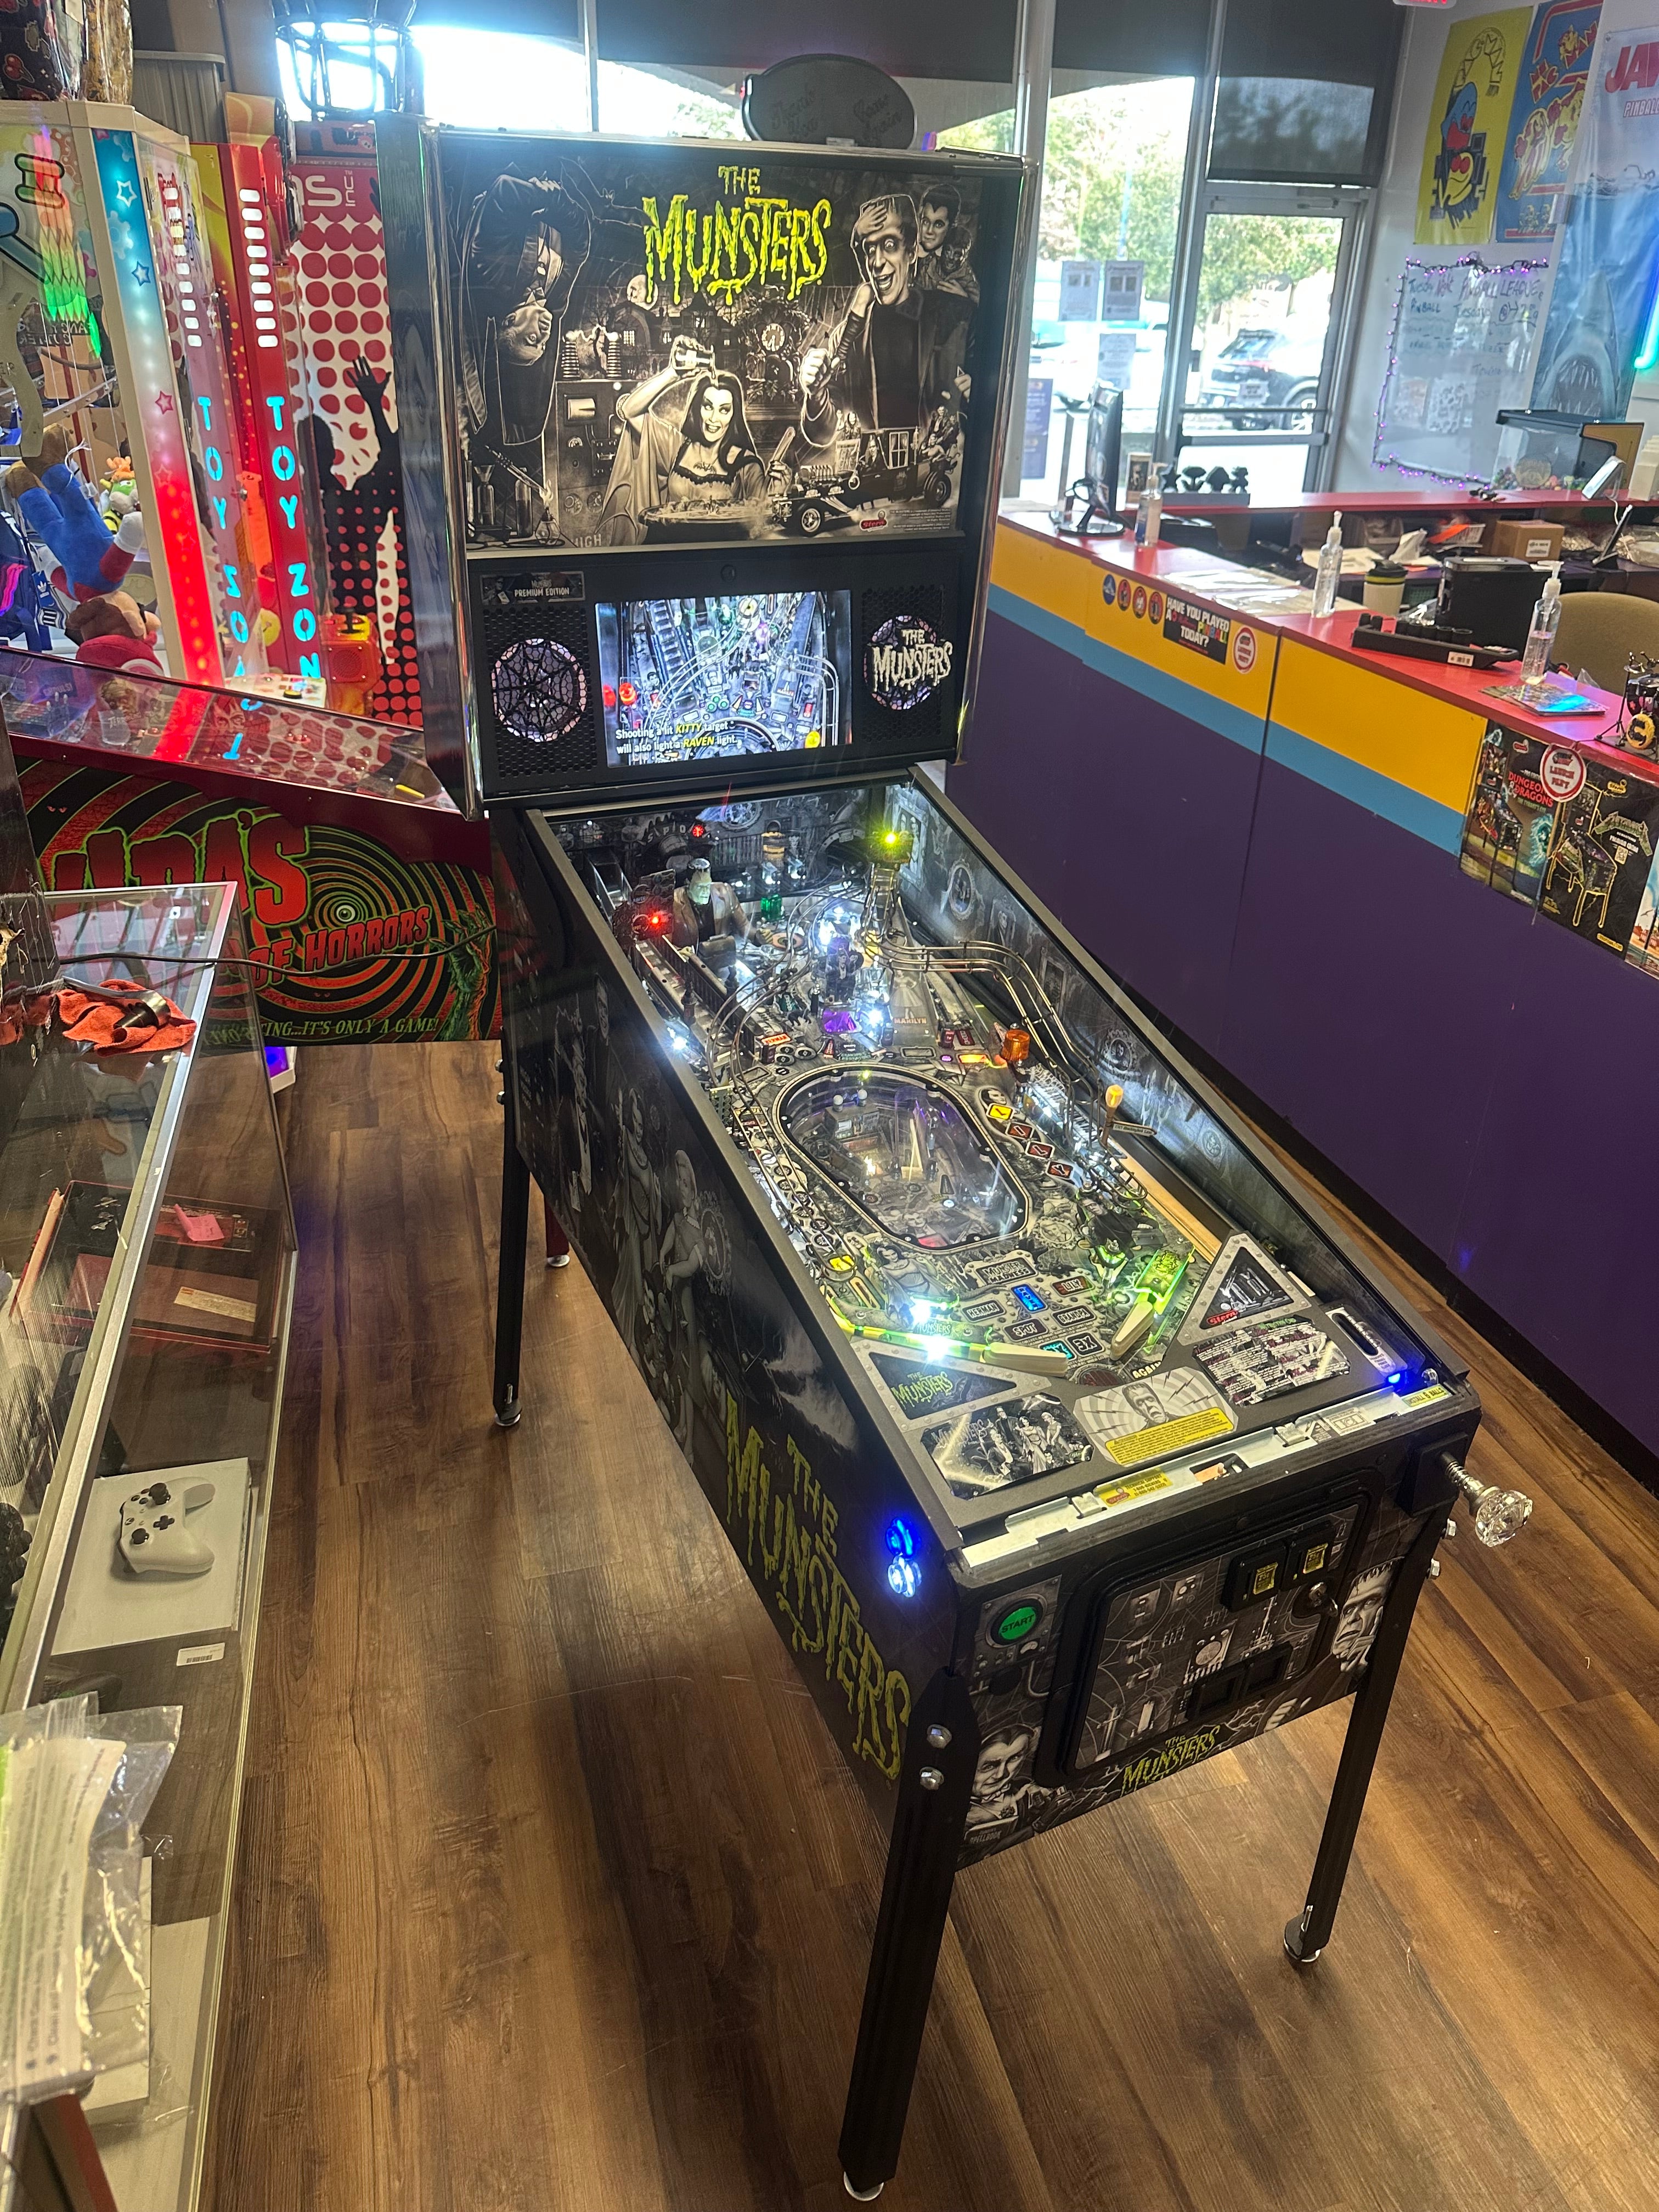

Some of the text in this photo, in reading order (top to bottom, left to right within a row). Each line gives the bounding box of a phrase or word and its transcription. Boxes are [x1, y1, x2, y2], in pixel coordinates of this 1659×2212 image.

[718, 166, 760, 194] THE
[642, 195, 832, 306] MUNSTERS
[515, 587, 569, 597] PREMIUM EDITION
[1167, 597, 1185, 614] HAVE
[1186, 604, 1201, 620] YOU
[1202, 611, 1229, 632] PLAYED
[1166, 609, 1172, 620] A
[1198, 621, 1227, 644] PINBALL
[901, 629, 925, 645] THE
[1181, 625, 1209, 647] TODAY?
[872, 641, 953, 692] MUNSTERS
[616, 729, 654, 739] Shooting
[665, 726, 673, 735] lit
[675, 723, 702, 733] KITTY
[704, 721, 728, 732] target
[617, 744, 631, 754] will
[634, 743, 652, 752] also
[654, 741, 673, 752] light
[683, 737, 714, 748] RAVEN
[1515, 784, 1554, 808] DRAGONS
[1609, 784, 1624, 792] Stern
[250, 906, 430, 988] OF HORRORS
[336, 1019, 374, 1035] ONLY
[379, 1020, 390, 1033] A
[396, 1018, 439, 1033] GAME!
[984, 1261, 1024, 1277] MUNSTER
[988, 1268, 1030, 1284] MADNESS
[1060, 1279, 1081, 1291] LILY
[967, 1302, 1000, 1318] HERMAN
[1057, 1308, 1091, 1324] GRANDPA
[1207, 1310, 1238, 1324] Stern
[1012, 1323, 1038, 1338] SPOT
[1073, 1335, 1098, 1352] 3X
[907, 1372, 923, 1381] THE
[891, 1371, 953, 1409] MUNSTERS
[1408, 1395, 1425, 1404] INSTALL
[1429, 1387, 1444, 1397] BALLS
[787, 1434, 838, 1557] THE
[727, 1389, 912, 1780] MUNSTERS
[1001, 1614, 1035, 1633] START
[1165, 1735, 1187, 1749] THE
[1121, 1724, 1221, 1797] MUNSTERS
[970, 1830, 1001, 1843] SPELLBOOK
